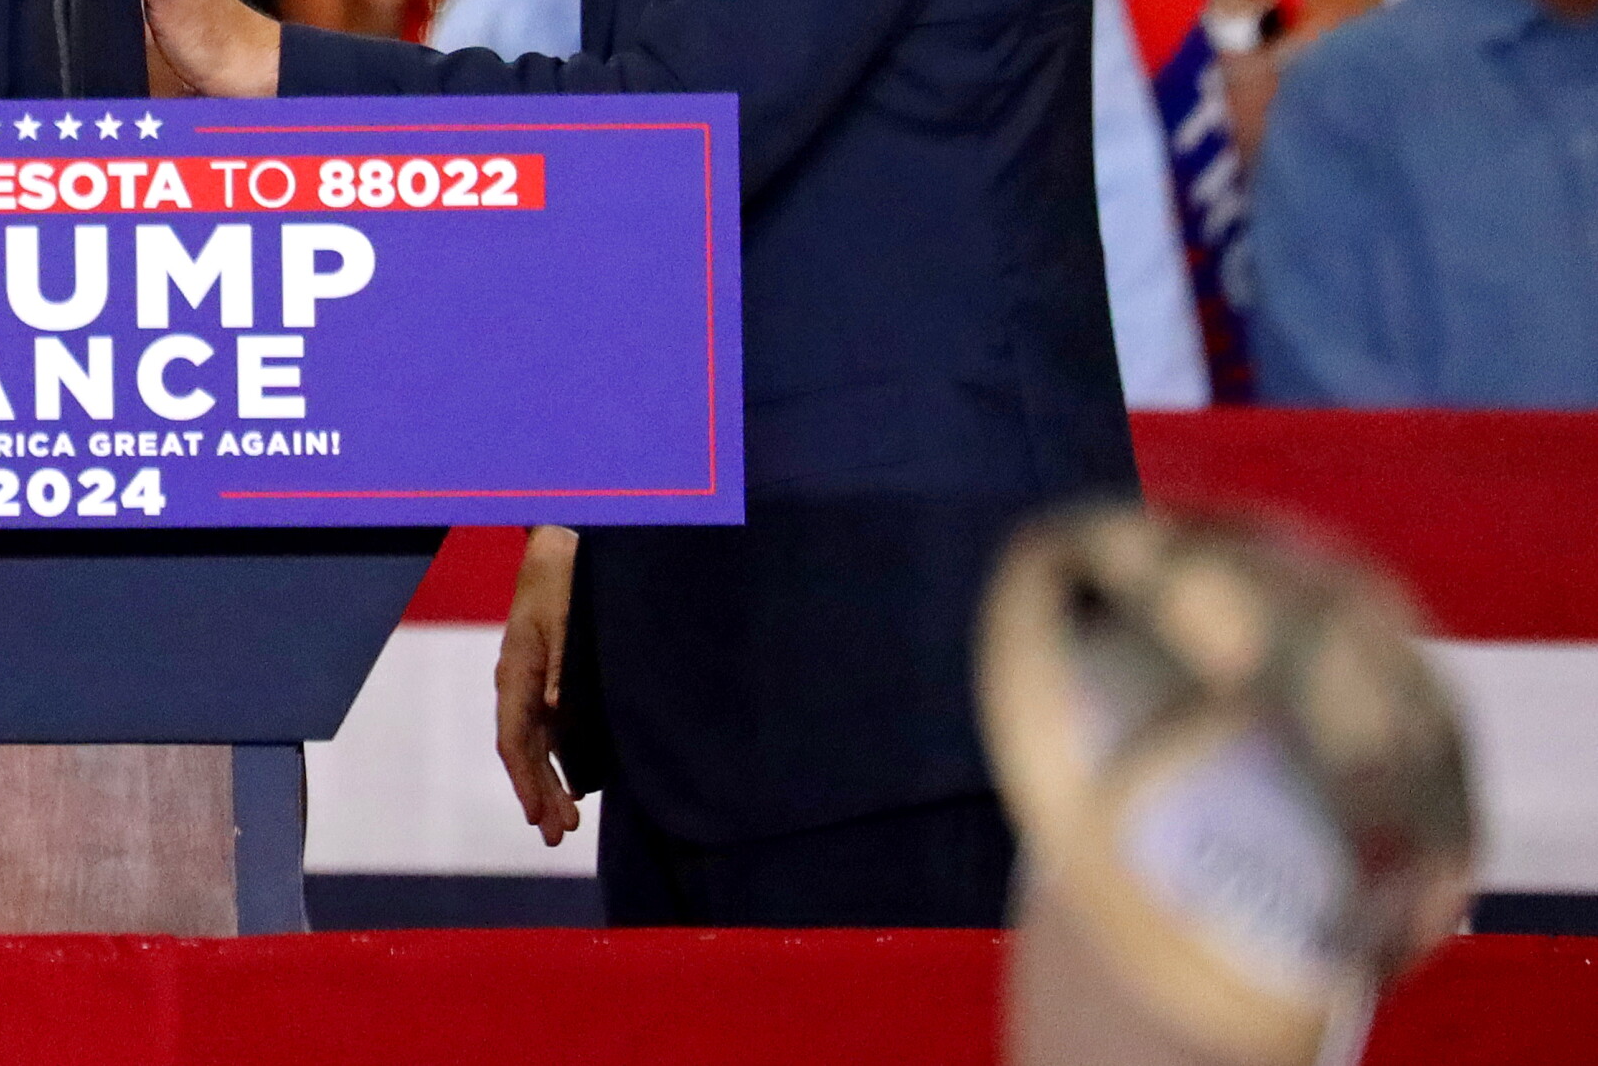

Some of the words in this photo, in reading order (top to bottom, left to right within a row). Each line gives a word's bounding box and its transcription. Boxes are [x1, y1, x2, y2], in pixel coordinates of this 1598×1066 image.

[209, 159, 297, 209] TO
[317, 157, 519, 208] 88022
[88, 430, 204, 457] GREAT
[216, 430, 341, 457] AGAIN!
